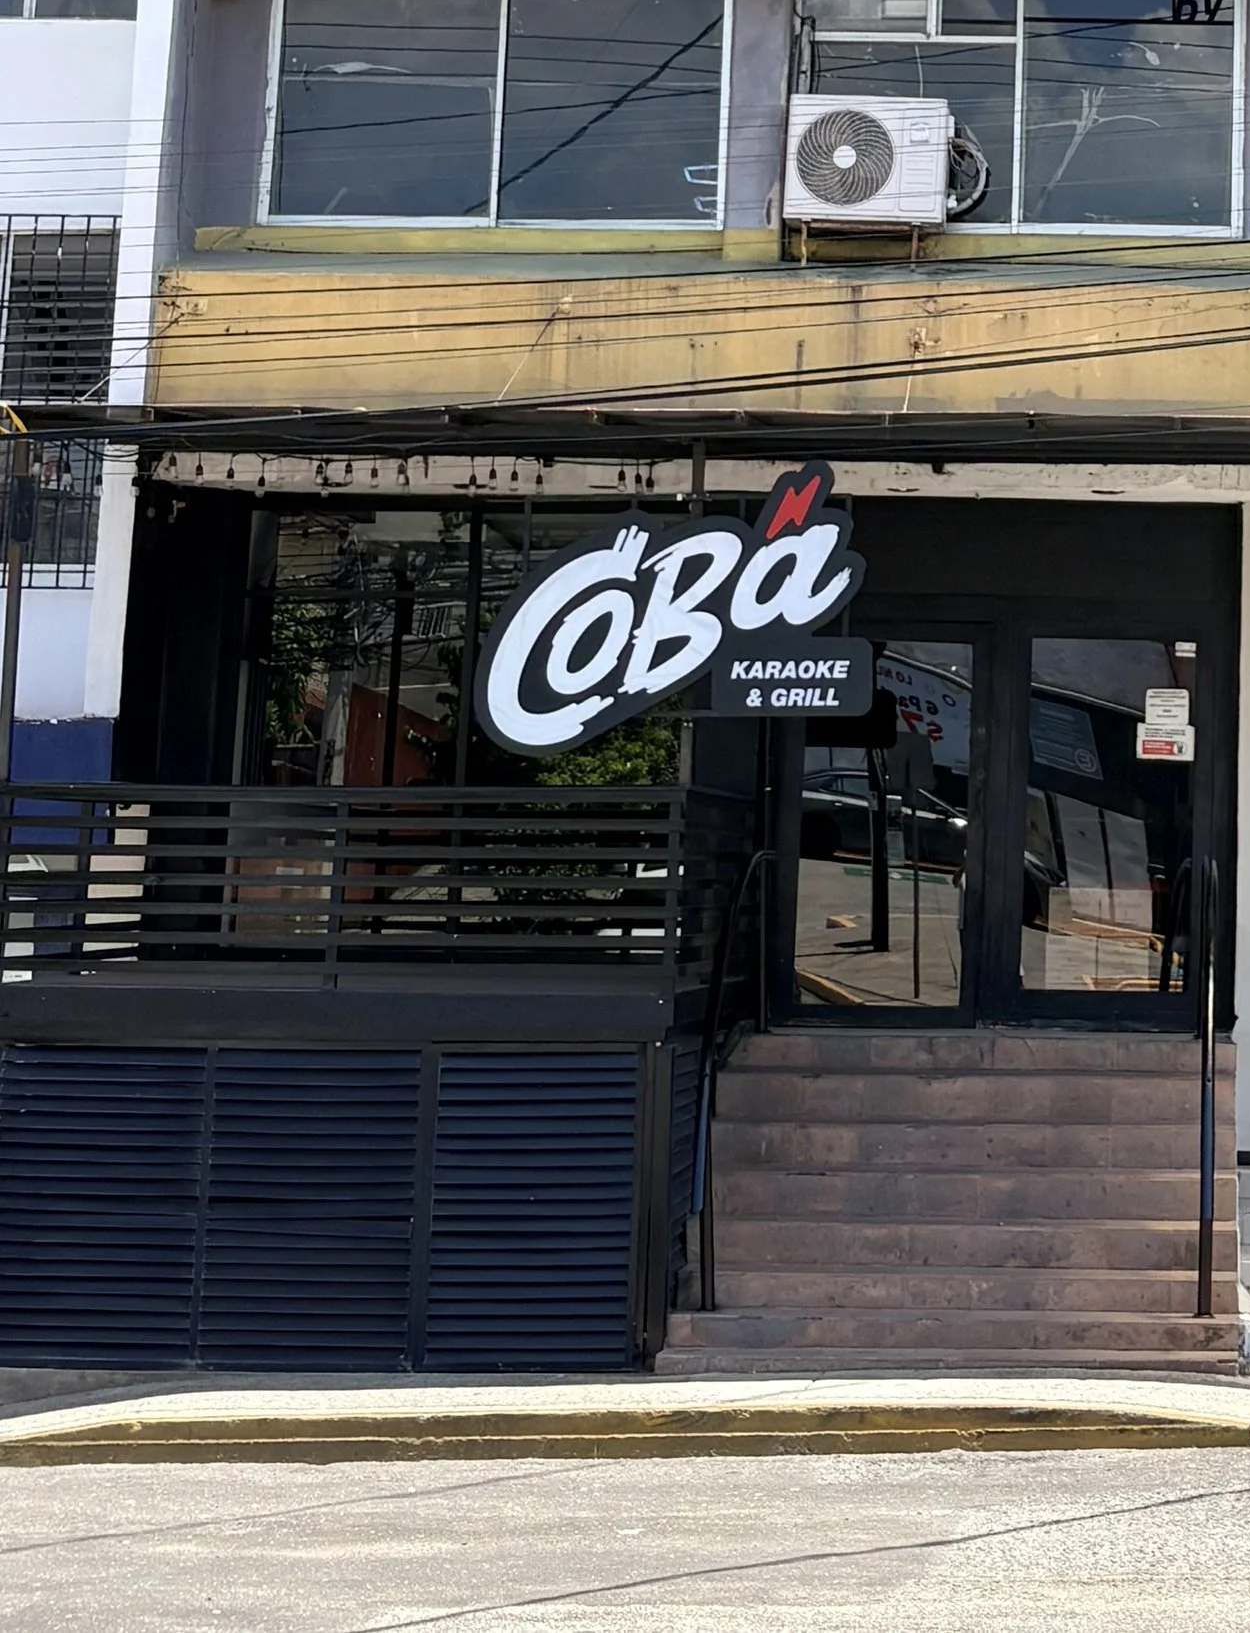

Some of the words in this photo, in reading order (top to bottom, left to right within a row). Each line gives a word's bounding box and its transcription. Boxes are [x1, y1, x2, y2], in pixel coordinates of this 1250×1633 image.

[730, 660, 851, 679] KARAOKE
[744, 689, 763, 707] &
[770, 689, 840, 707] GRILL
